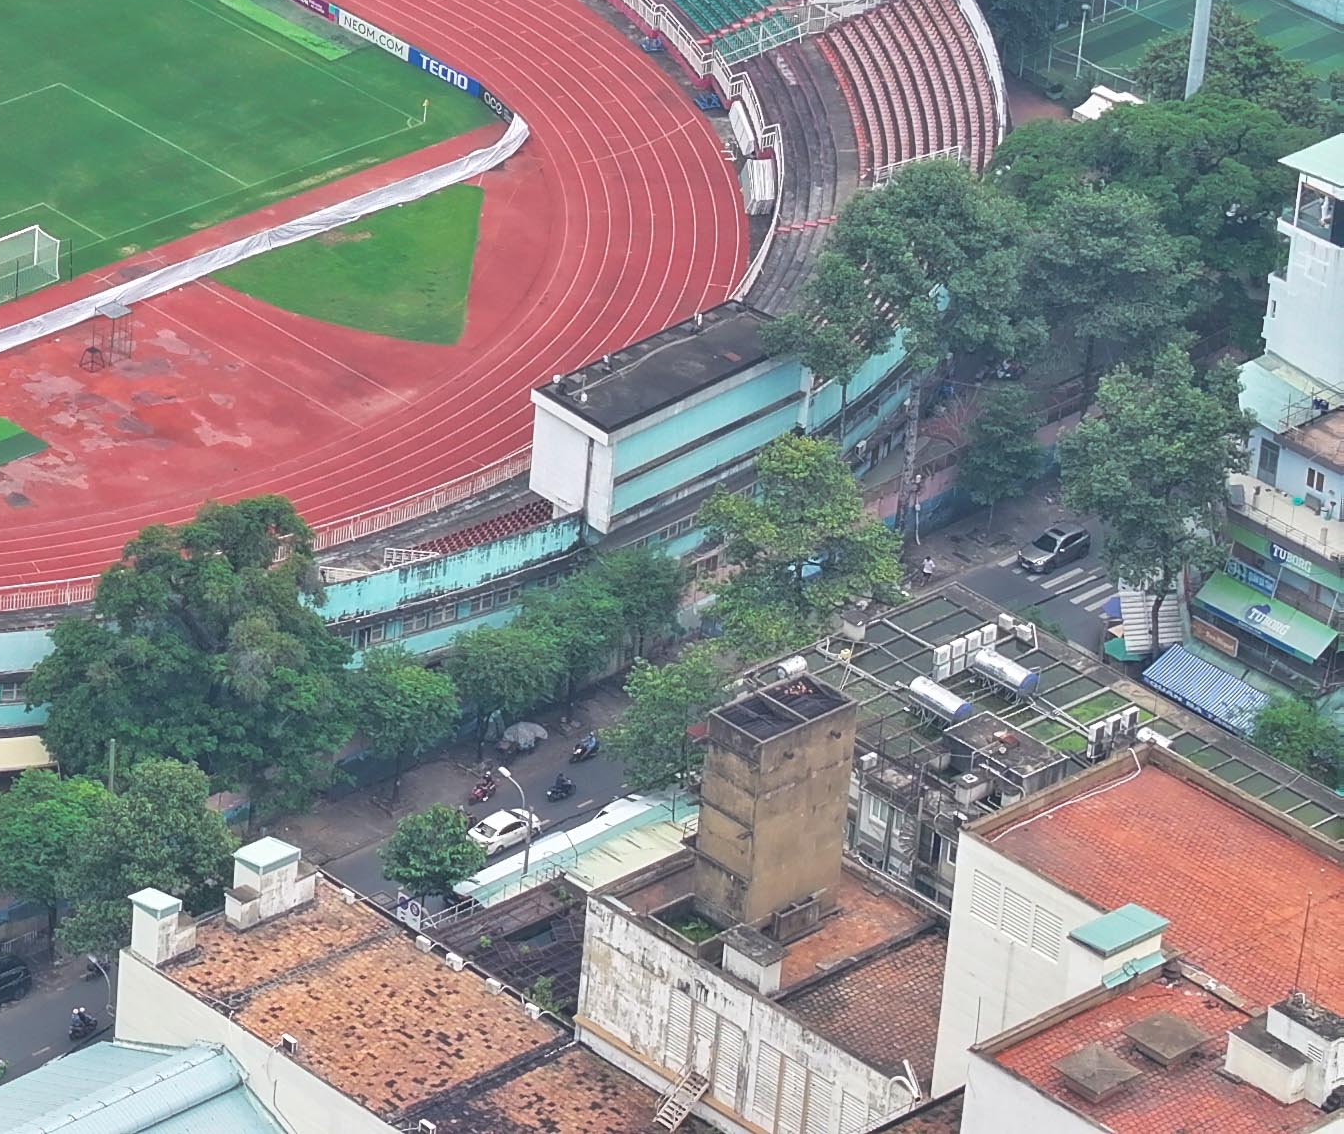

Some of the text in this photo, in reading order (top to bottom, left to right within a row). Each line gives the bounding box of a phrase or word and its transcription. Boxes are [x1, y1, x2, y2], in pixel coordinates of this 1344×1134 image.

[343, 15, 403, 55] NEOM.COM
[419, 52, 468, 91] TECNO
[1272, 543, 1312, 574] TUBORG
[1247, 608, 1291, 637] TUBORG
